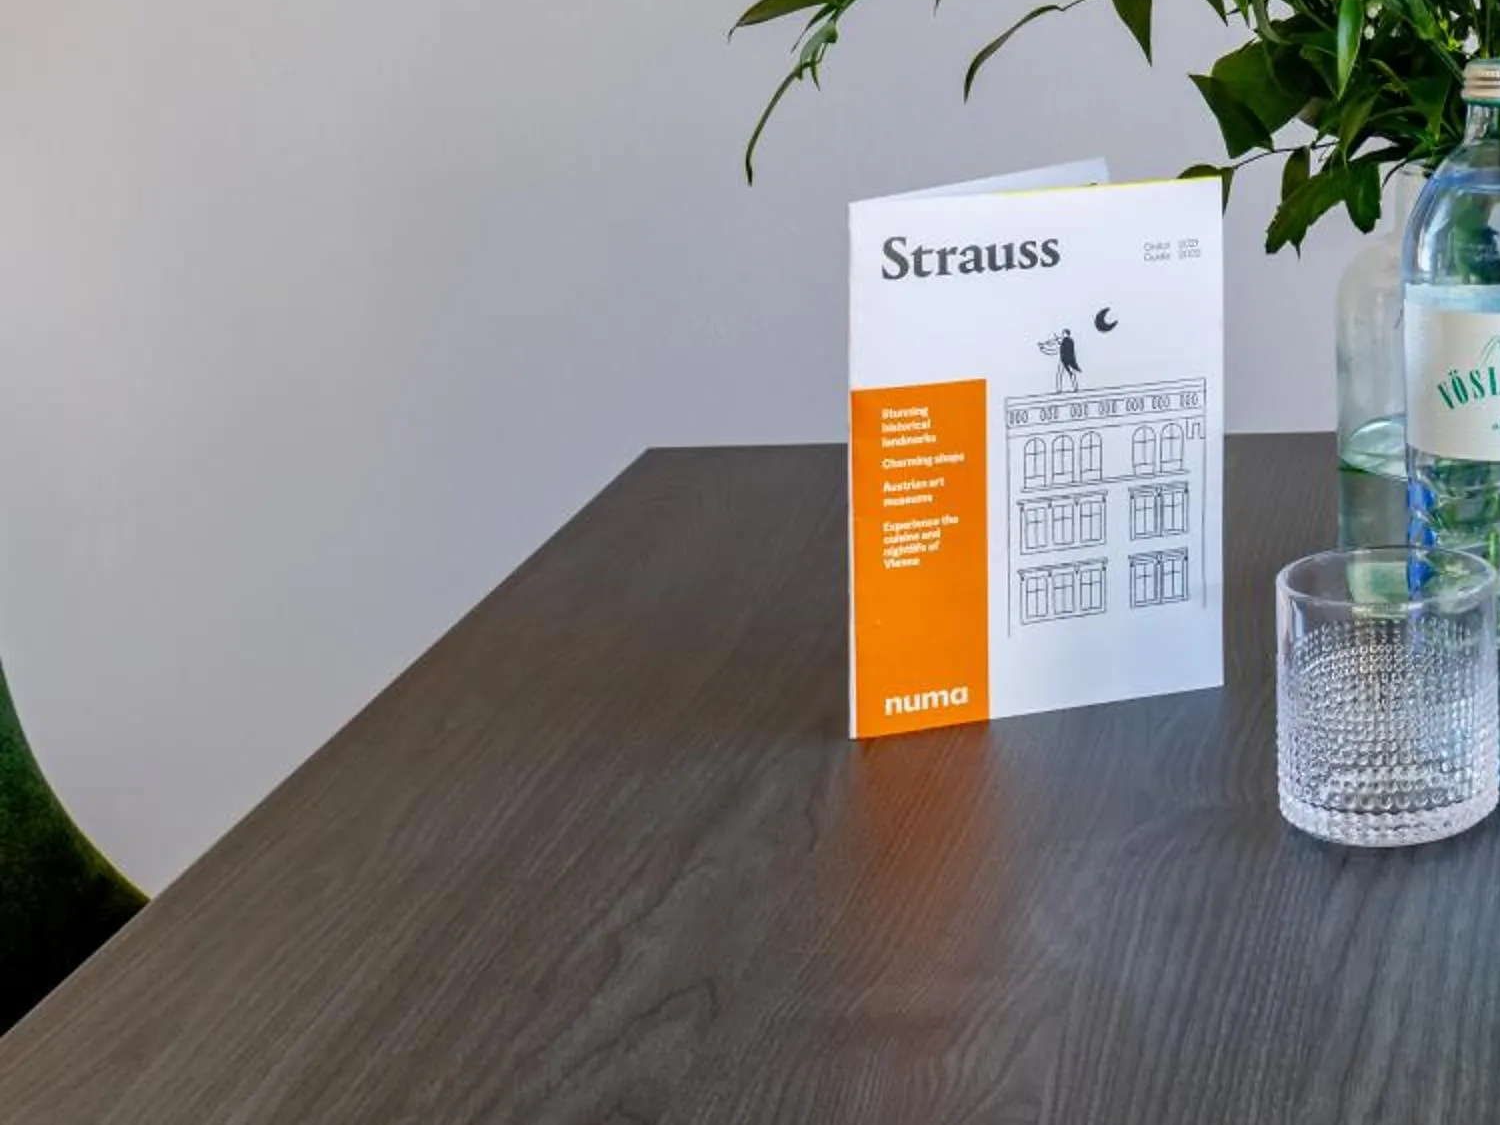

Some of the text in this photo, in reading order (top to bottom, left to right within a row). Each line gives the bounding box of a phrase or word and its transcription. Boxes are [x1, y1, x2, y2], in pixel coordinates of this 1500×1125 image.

[881, 235, 1061, 280] Strauss
[882, 434, 937, 447] landmarks
[882, 455, 933, 468] Charming
[885, 685, 969, 716] numa
